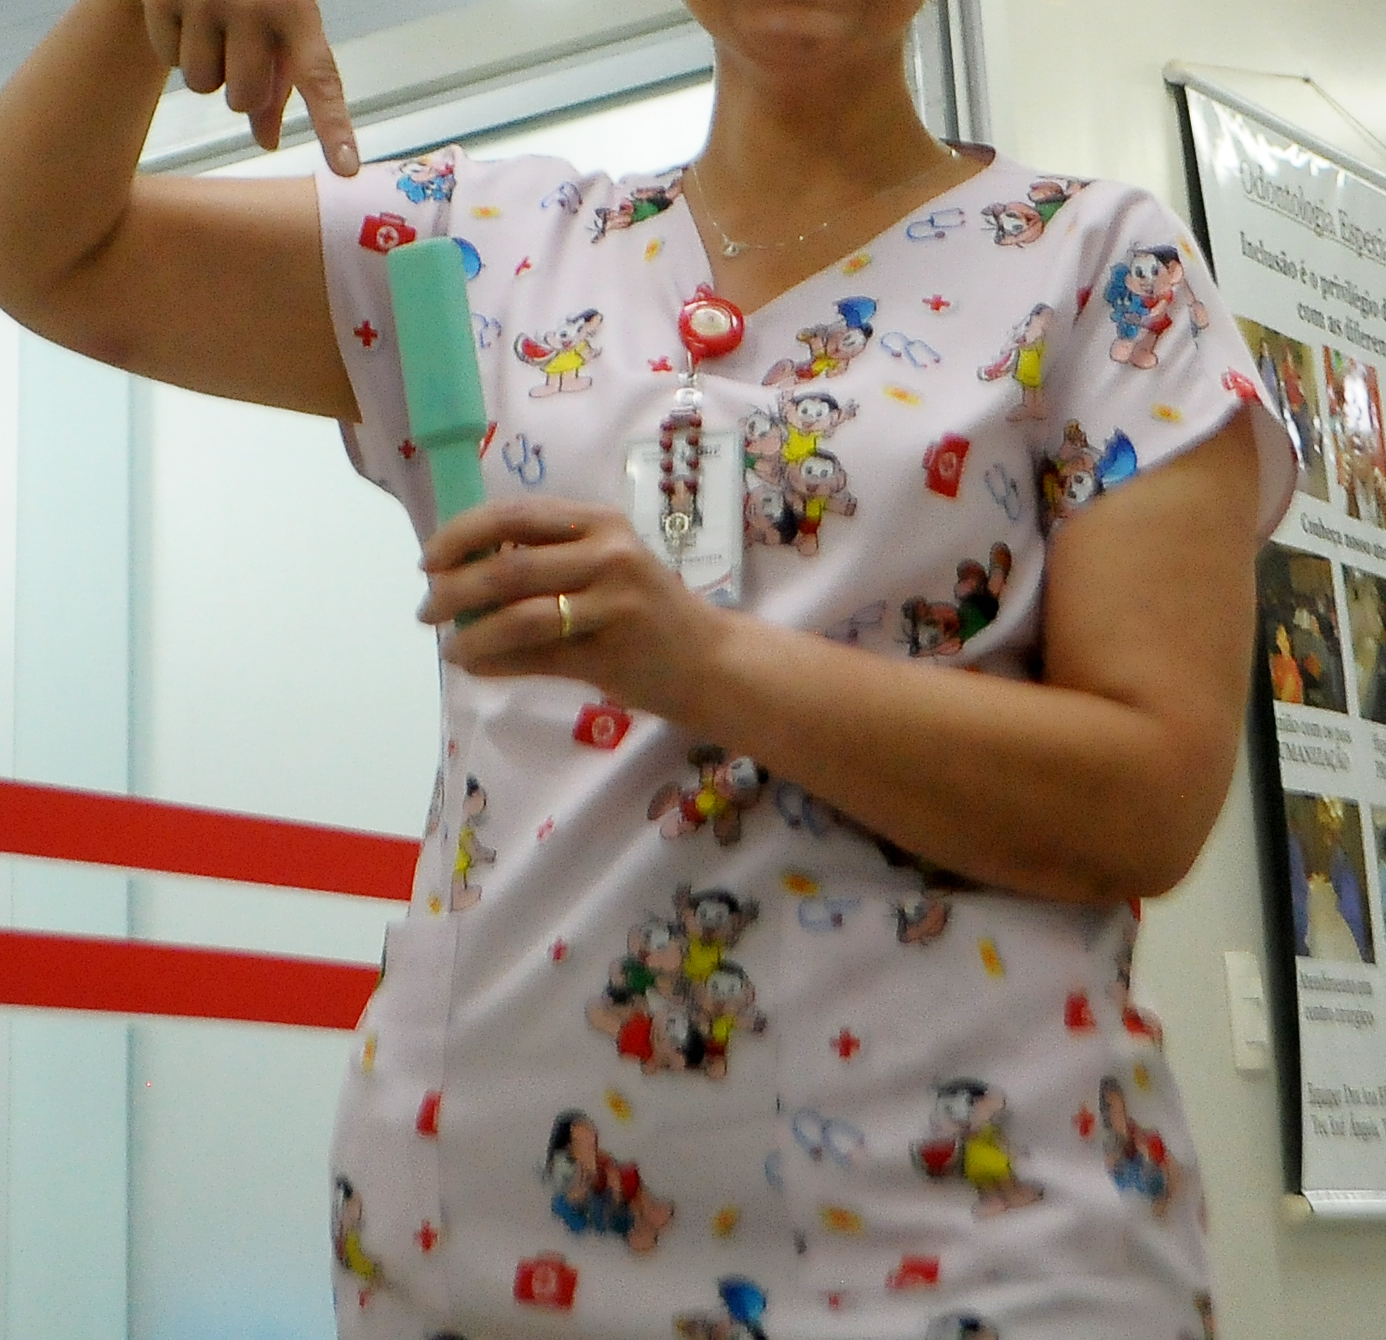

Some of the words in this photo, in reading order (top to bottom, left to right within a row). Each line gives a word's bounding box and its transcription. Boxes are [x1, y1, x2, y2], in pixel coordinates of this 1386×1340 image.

[1240, 160, 1336, 237] Odontologia
[1240, 231, 1297, 279] Inclusão
[1299, 259, 1307, 285] é
[1309, 271, 1318, 290] o
[1319, 274, 1380, 319] privilégio
[1297, 302, 1325, 329] com
[1327, 315, 1343, 337] as
